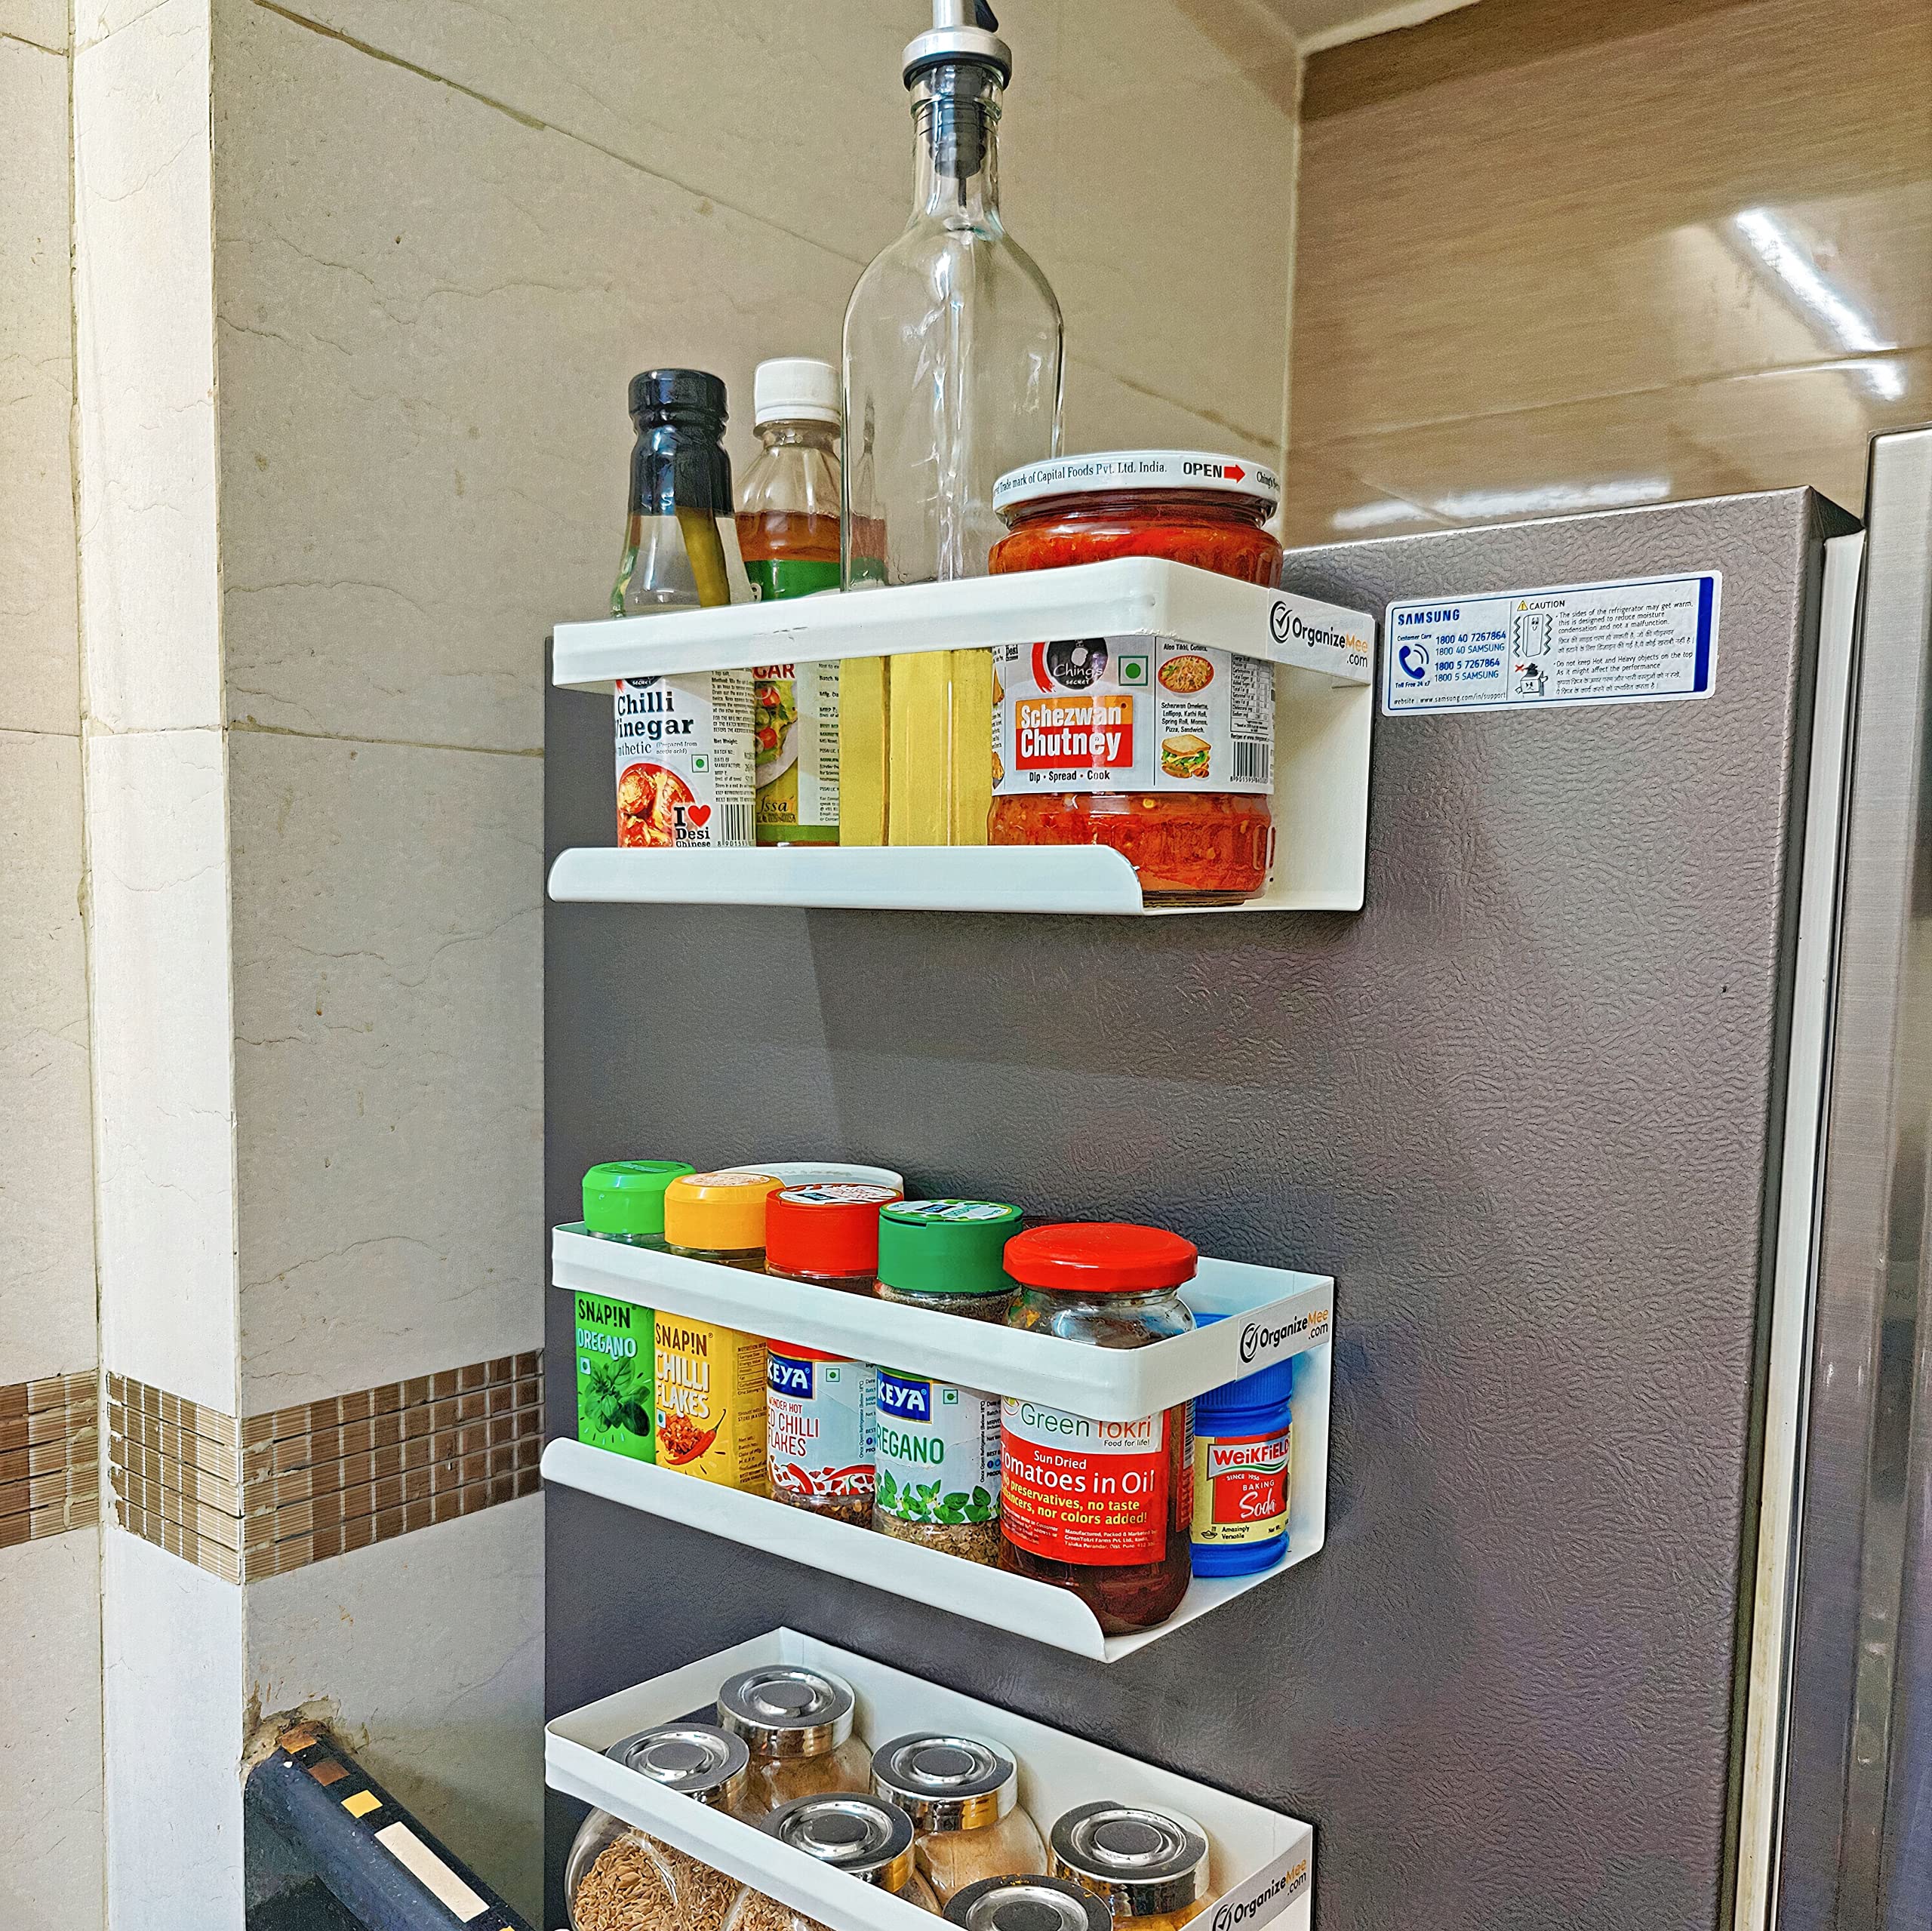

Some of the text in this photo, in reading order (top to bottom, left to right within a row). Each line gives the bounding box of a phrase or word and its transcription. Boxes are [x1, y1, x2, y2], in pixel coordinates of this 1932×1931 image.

[1013, 474, 1027, 487] mark
[1029, 472, 1035, 483] of
[1037, 467, 1065, 484] Capital
[1068, 465, 1094, 478] Foods
[1096, 463, 1114, 475] Pvt.
[1118, 462, 1136, 473] Ltd.
[1140, 461, 1167, 472] India.
[1183, 462, 1223, 478] OPEN
[1529, 600, 1565, 610] CAUTION
[1608, 605, 1643, 614] refrigerator
[1660, 603, 1671, 611] get
[1398, 609, 1460, 626] SAMSUNG
[1578, 616, 1604, 626] designed
[1292, 617, 1367, 653] OrganizeMee
[1435, 631, 1506, 644] 1800 40 7267864
[1558, 625, 1597, 634] condensation
[1435, 643, 1505, 656] 1800 40 SAMSUNG
[1638, 653, 1659, 663] objects
[1347, 653, 1367, 667] .com
[1435, 658, 1500, 671] 1800 5 7267864
[752, 664, 795, 679] GAR
[1053, 664, 1103, 679] Chings
[1435, 670, 1499, 682] 1800 5 SAMSUNG
[1572, 667, 1589, 676] might
[617, 691, 675, 716] Chilli
[1021, 704, 1121, 729] Schezwan
[617, 741, 651, 756] nthetic
[1021, 728, 1121, 761] Chutney
[1029, 770, 1110, 783] Dip Spread Cook
[674, 807, 686, 827] I
[675, 826, 710, 840] Desi
[1260, 1309, 1328, 1348] OrganizeMee
[1309, 1323, 1328, 1339] .com
[577, 1327, 638, 1361] OREGANO
[656, 1349, 710, 1393] CHILLI
[767, 1358, 808, 1389] KEYA
[656, 1380, 711, 1419] FLAKES
[878, 1379, 925, 1412] KEYA
[770, 1397, 802, 1413] NDER HOT
[779, 1413, 819, 1437] CHILLI
[1021, 1403, 1090, 1437] Green
[877, 1422, 944, 1465] REGANO
[1001, 1441, 1154, 1494] Tomatoes in Oil
[1034, 1450, 1087, 1470] Sun Dried
[1242, 1480, 1275, 1491] BAKING
[1011, 1482, 1084, 1511] preservatives,
[1088, 1500, 1104, 1510] no
[1109, 1500, 1140, 1511] taste
[1239, 1488, 1276, 1519] Soda
[1038, 1506, 1058, 1518] nor
[1060, 1511, 1100, 1524] colors
[1105, 1511, 1146, 1525] added!
[1222, 1525, 1250, 1535] Amazingly
[1234, 1859, 1306, 1923] OrganizeMee
[1287, 1872, 1306, 1896] .com
